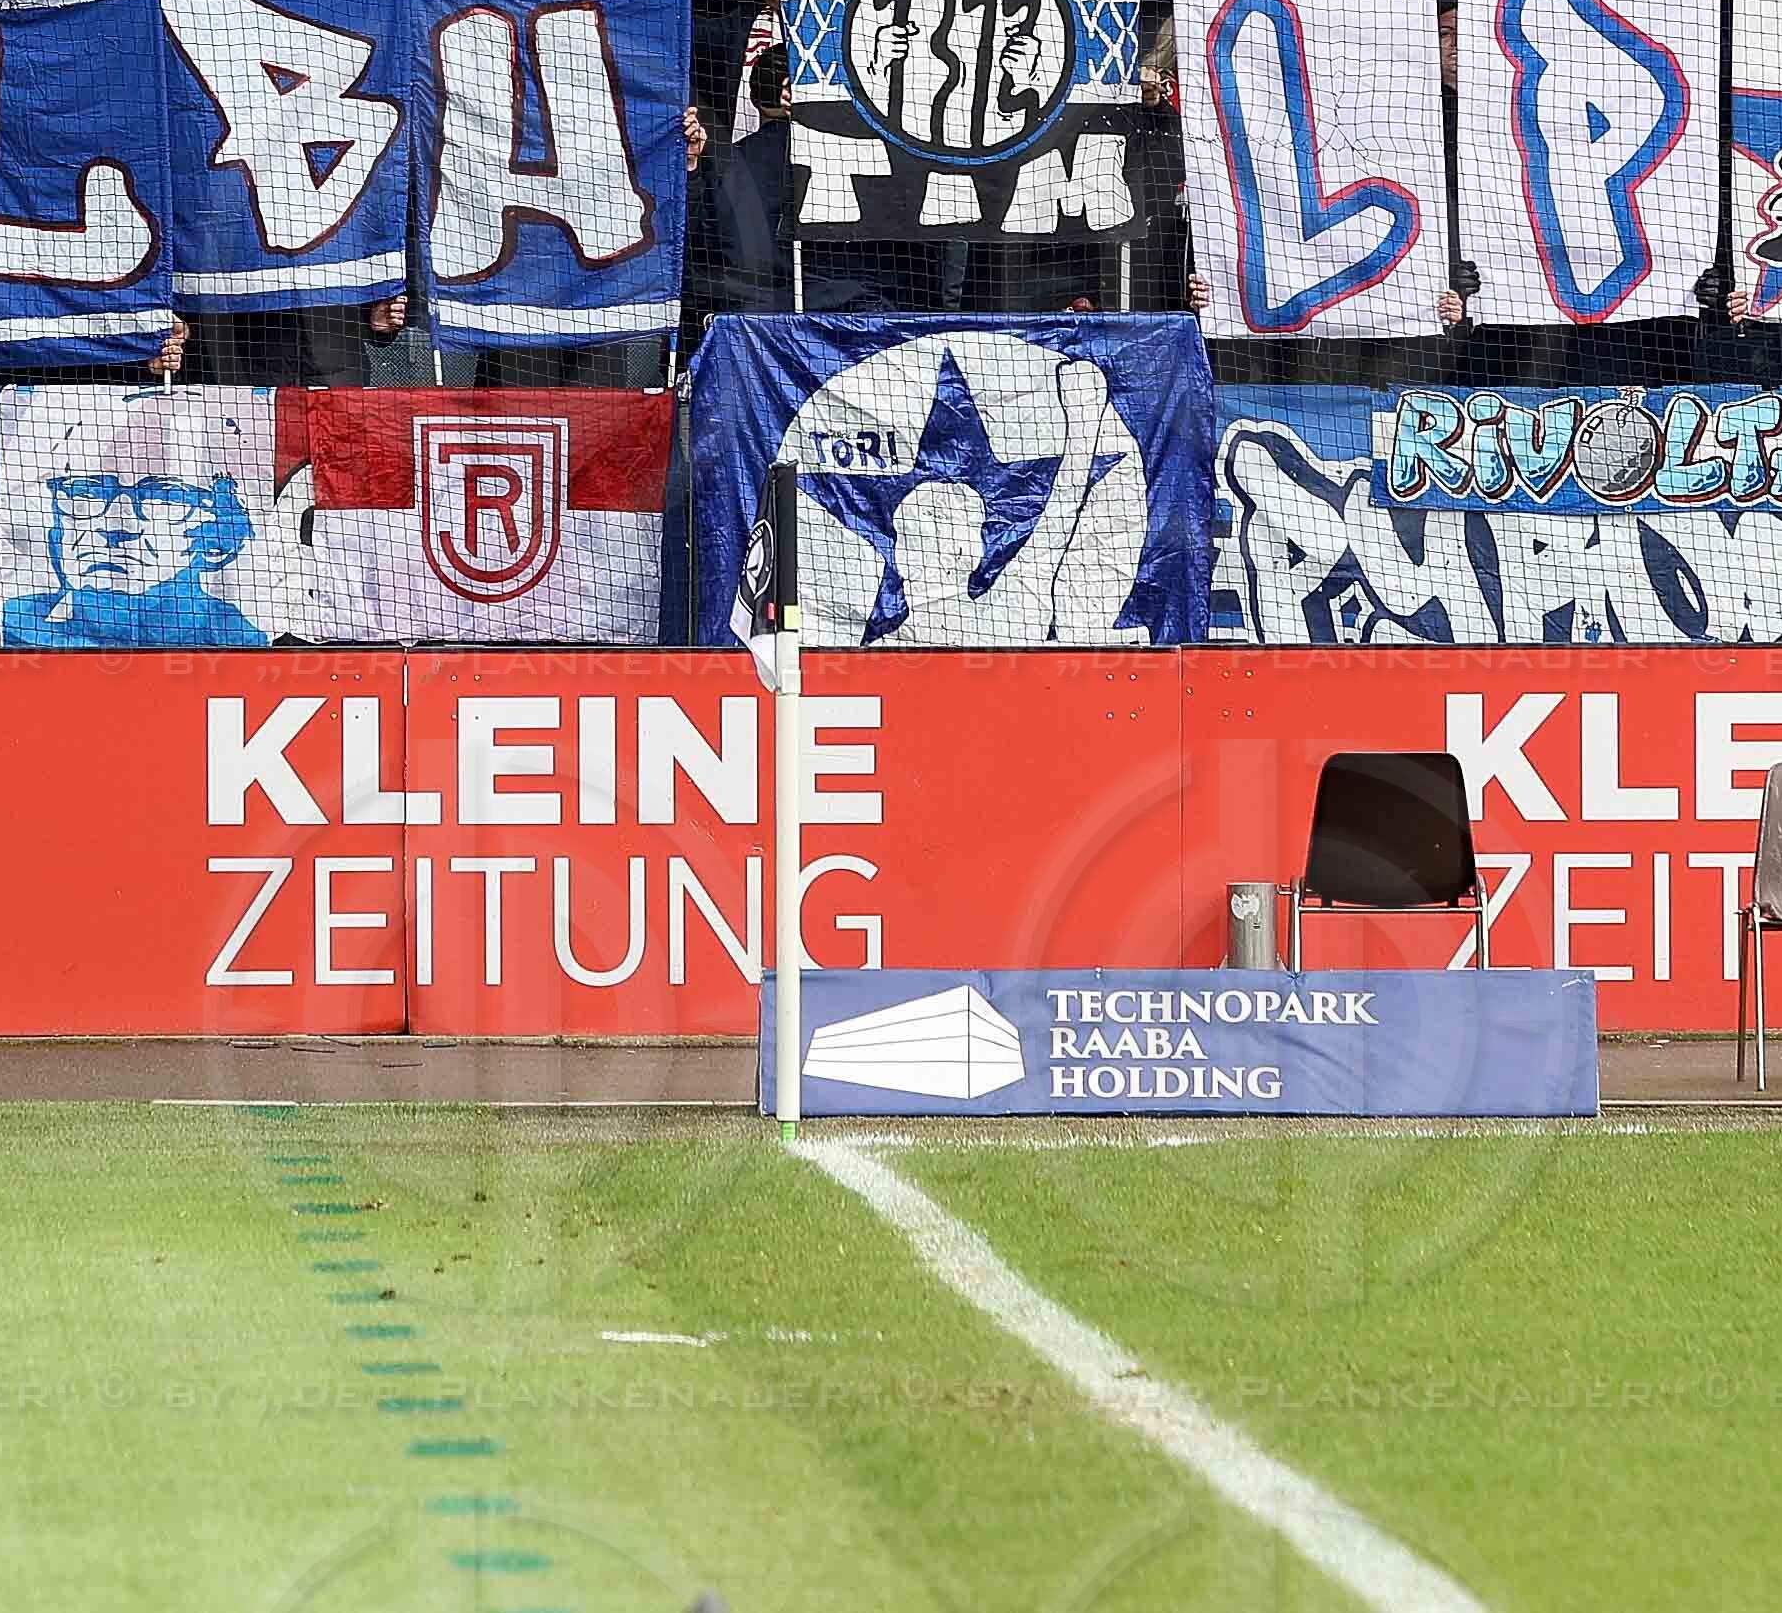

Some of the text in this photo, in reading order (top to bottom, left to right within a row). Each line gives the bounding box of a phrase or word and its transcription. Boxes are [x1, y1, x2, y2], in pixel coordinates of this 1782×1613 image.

[206, 695, 883, 826] KLEINE
[206, 855, 883, 986] ZEITUNG
[1046, 990, 1378, 1025] TECHNOPARK
[1050, 1027, 1206, 1061] RAABA
[1050, 1066, 1282, 1100] HOLDING
